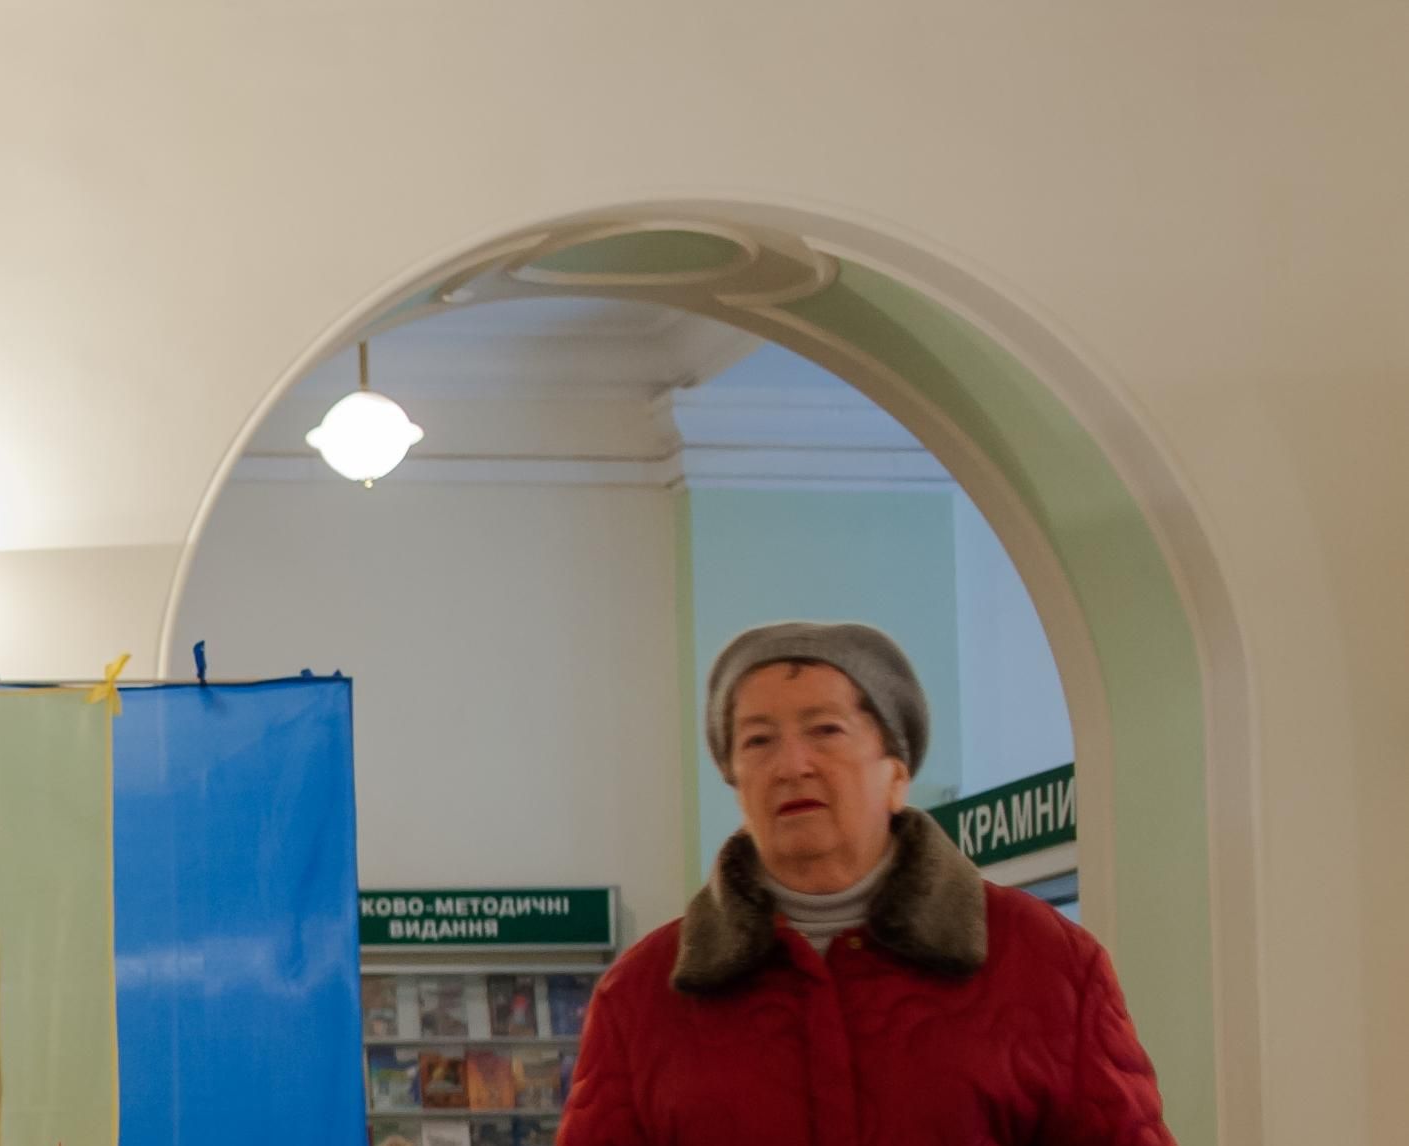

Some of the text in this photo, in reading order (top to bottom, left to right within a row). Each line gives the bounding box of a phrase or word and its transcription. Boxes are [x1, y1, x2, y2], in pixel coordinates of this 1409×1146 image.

[958, 776, 1076, 856] КРАМНИ
[359, 896, 570, 918] КОВО-МЕТОДИЧНІ
[389, 919, 498, 941] ВИДАННЯ
